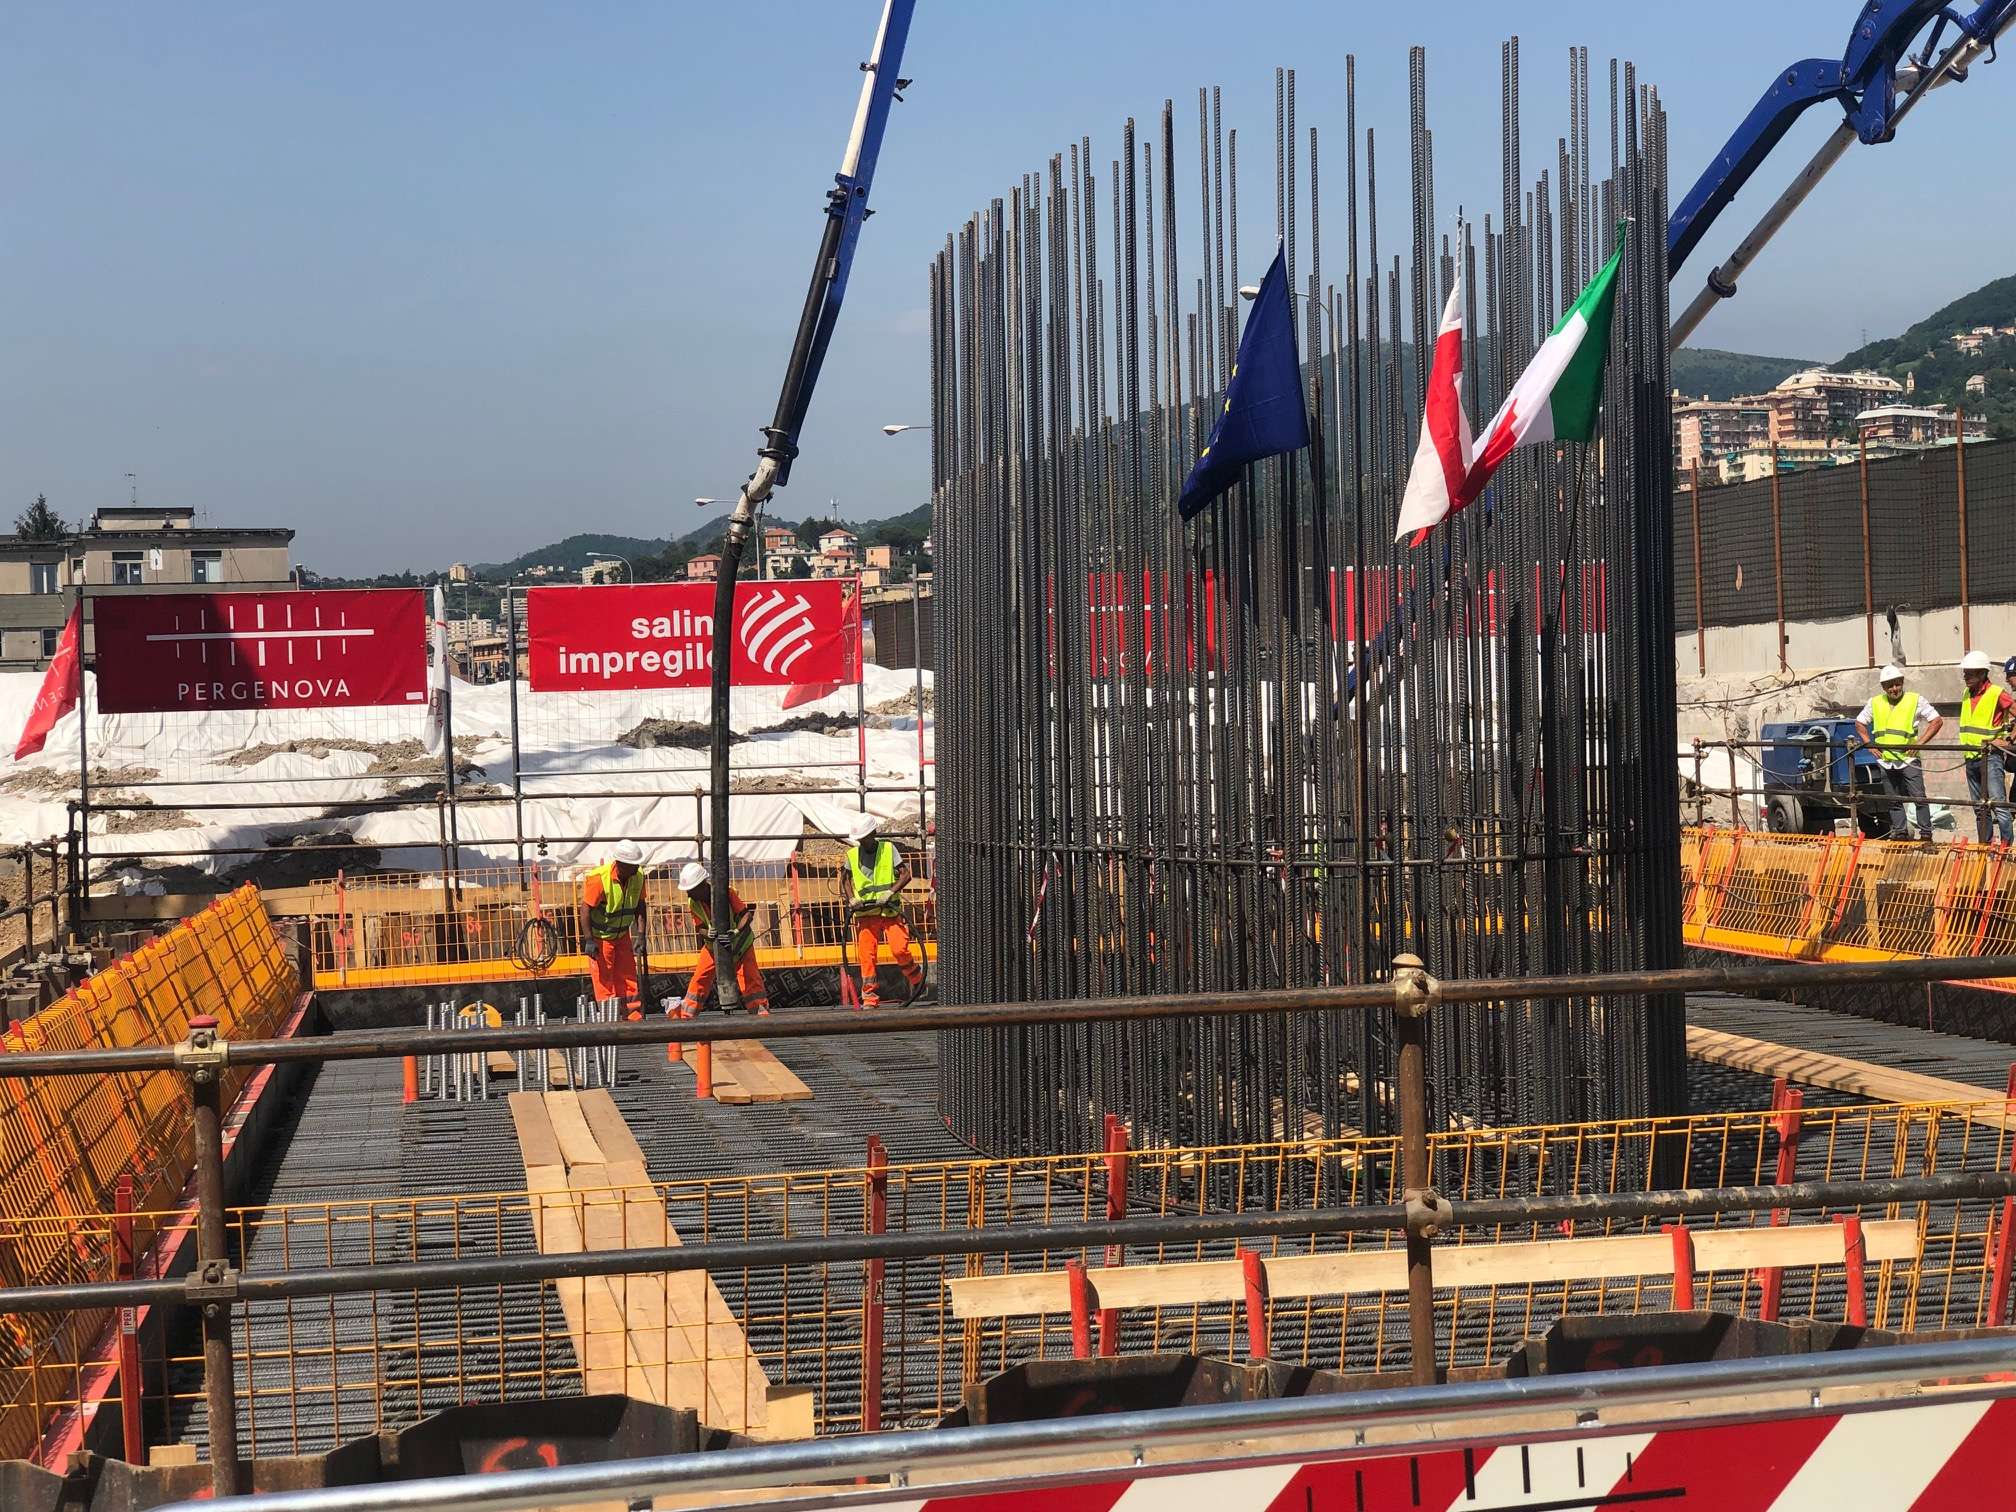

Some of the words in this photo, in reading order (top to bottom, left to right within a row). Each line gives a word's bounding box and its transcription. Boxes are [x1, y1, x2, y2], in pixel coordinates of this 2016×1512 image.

[631, 609, 714, 638] salin
[177, 678, 351, 701] PERGENOVA
[123, 1309, 132, 1326] PERI
